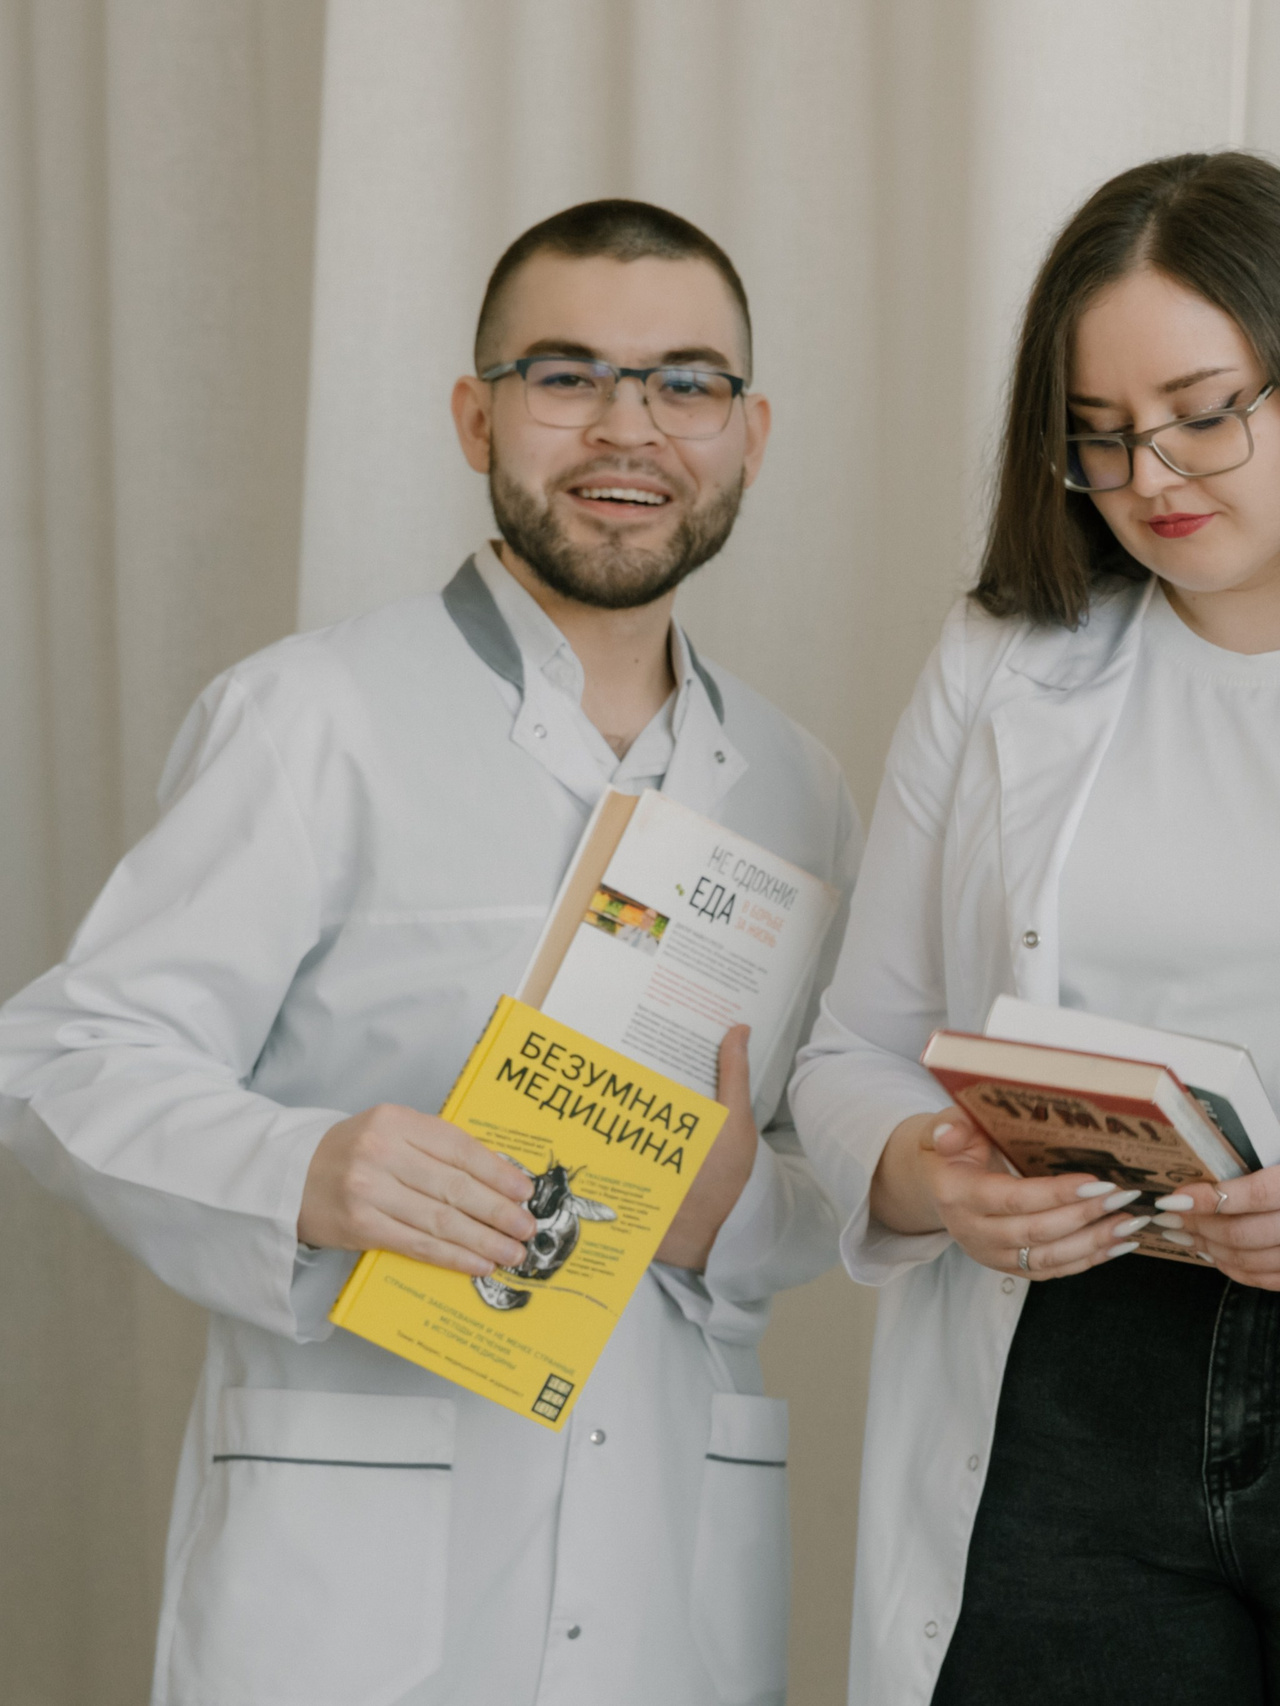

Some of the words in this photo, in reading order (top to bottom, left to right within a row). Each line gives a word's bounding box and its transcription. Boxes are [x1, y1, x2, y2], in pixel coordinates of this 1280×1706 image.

[689, 876, 736, 925] ЕДА
[708, 846, 734, 875] НЕ
[732, 859, 798, 910] СДОХНИ!
[496, 1058, 684, 1174] МЕДИЦИНА
[520, 1031, 700, 1140] БЕЗУМНАЯ
